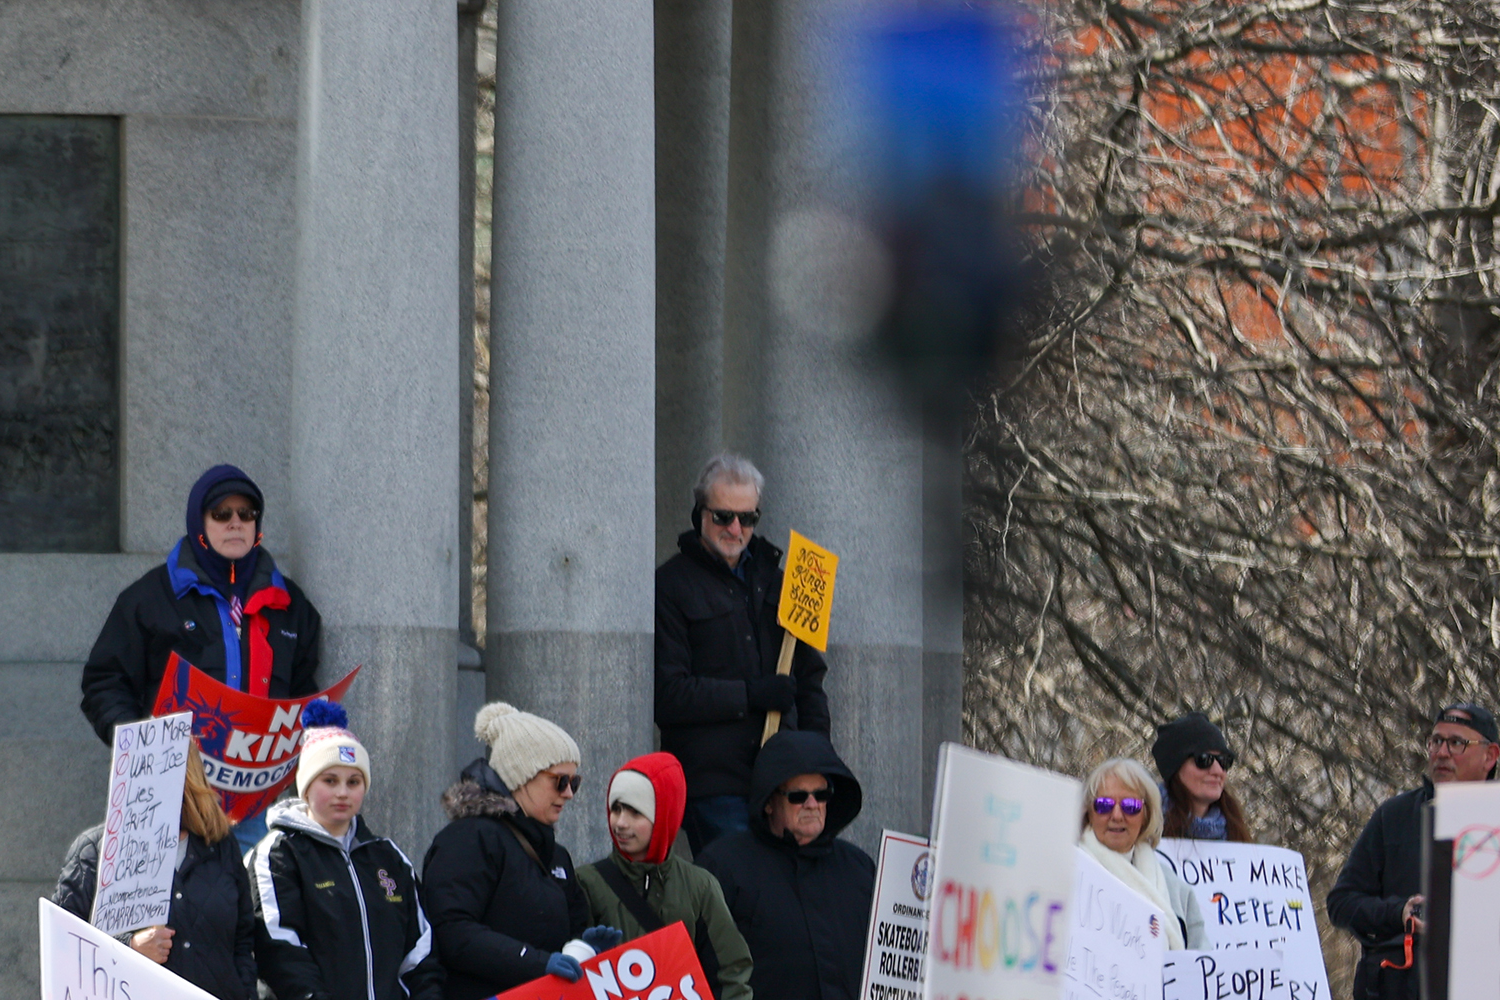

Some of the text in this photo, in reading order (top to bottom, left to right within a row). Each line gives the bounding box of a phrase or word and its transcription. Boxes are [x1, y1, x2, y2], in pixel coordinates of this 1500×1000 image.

[787, 603, 820, 633] 1776
[136, 721, 157, 750] NO
[126, 780, 155, 807] Lies
[1250, 858, 1304, 893] MAKE
[933, 878, 1064, 975] CHOOSE
[1211, 892, 1304, 932] REPEAT
